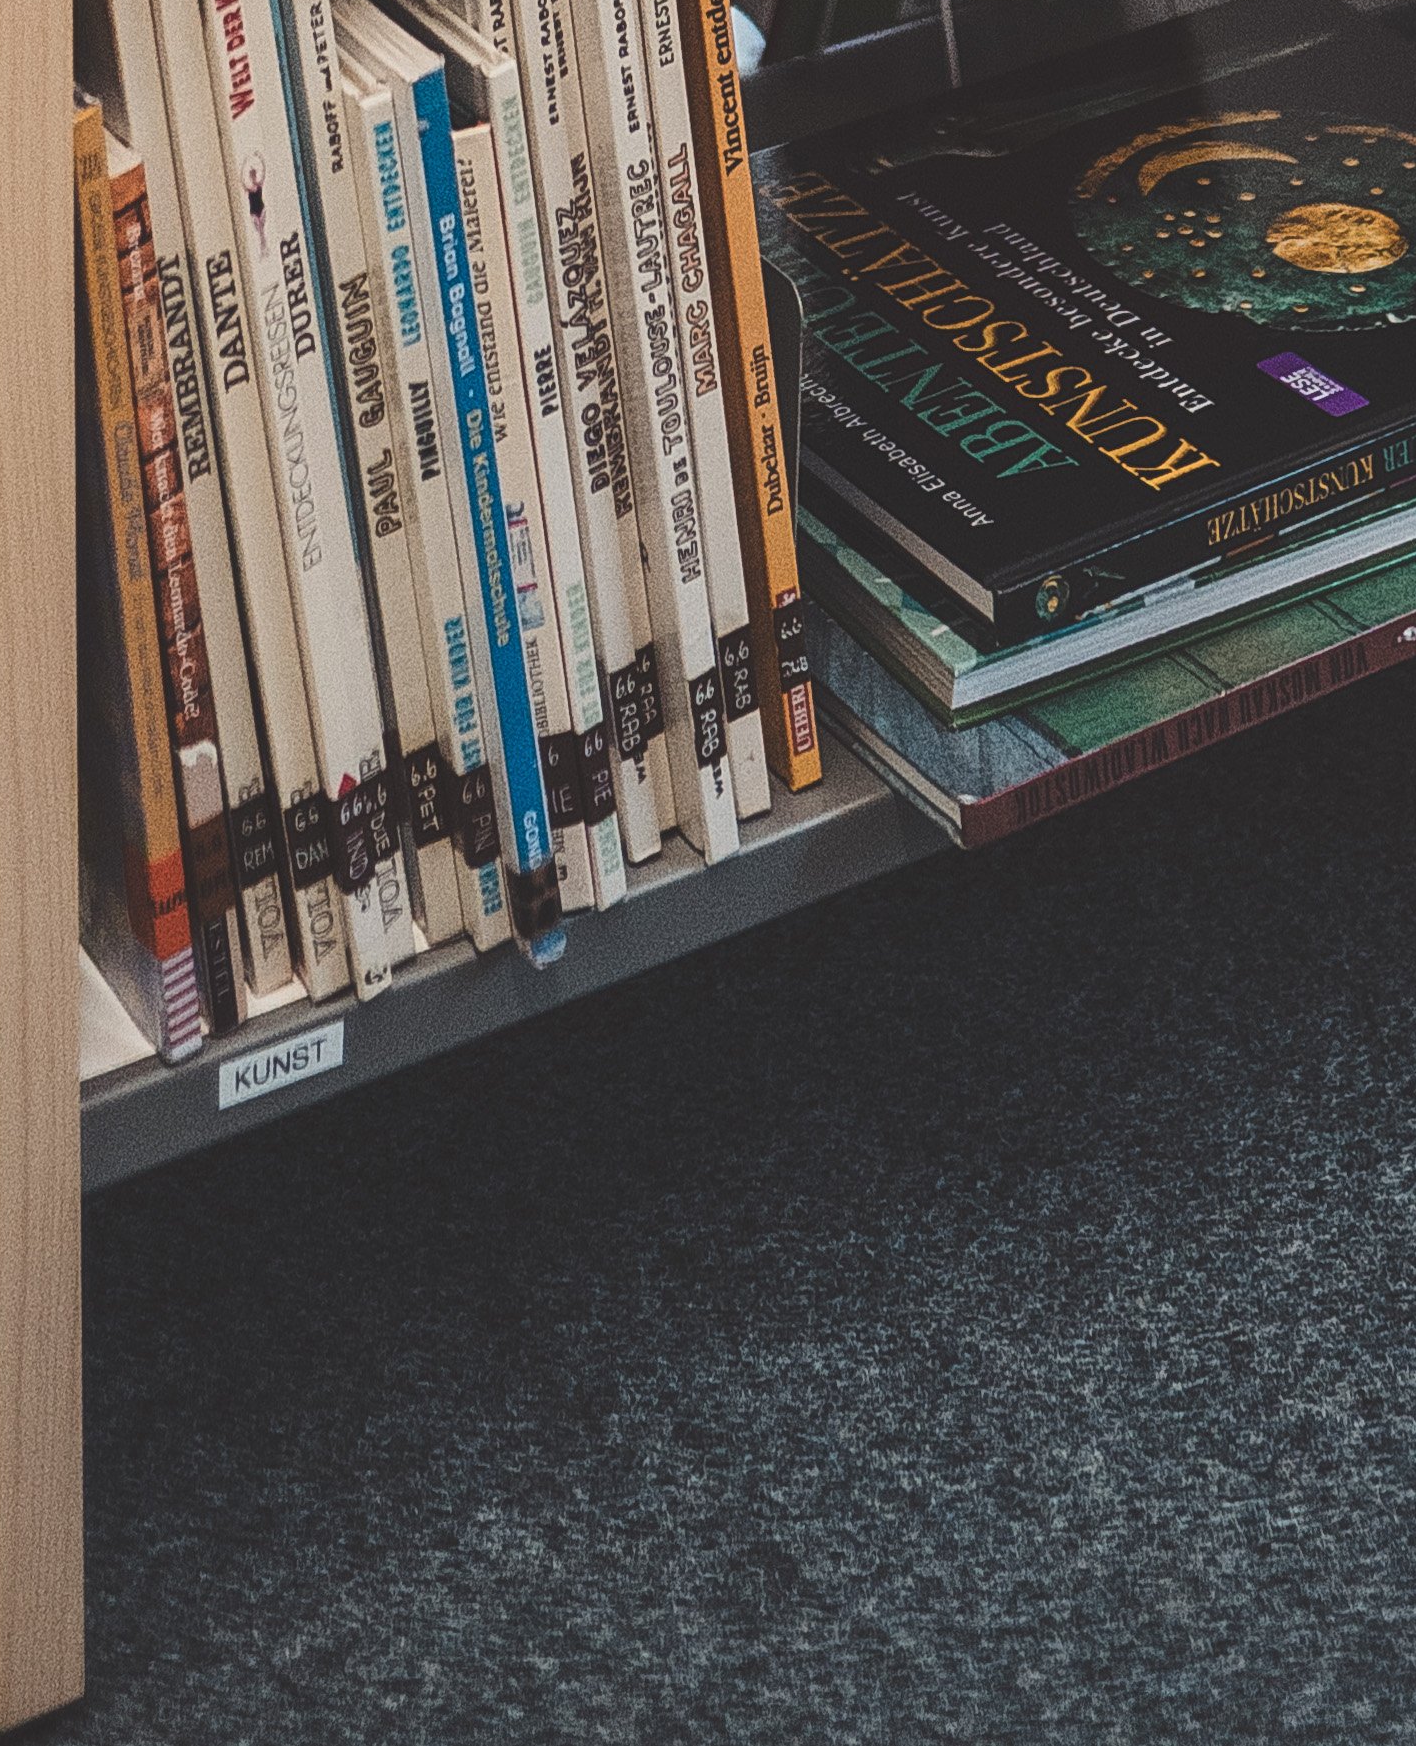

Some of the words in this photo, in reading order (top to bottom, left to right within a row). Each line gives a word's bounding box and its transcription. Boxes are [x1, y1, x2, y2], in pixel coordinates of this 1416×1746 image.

[231, 66, 256, 119] WELT
[326, 99, 343, 173] RABOFF
[621, 66, 640, 133] ERNEST
[712, 69, 745, 176] Vincent
[668, 141, 704, 294] CHAGALL
[207, 250, 251, 393] DANTE
[391, 244, 421, 347] LEONARDO
[447, 281, 473, 375] Bagnall
[157, 255, 212, 484] REMBRANDT
[339, 272, 386, 428] GAUGUIN
[534, 343, 559, 417] PIERRE
[683, 301, 717, 398] MARC
[750, 344, 772, 407] Bruijn
[364, 447, 402, 539] PAUL
[762, 424, 785, 516] Dubelaar
[234, 1037, 327, 1092] KUNST
